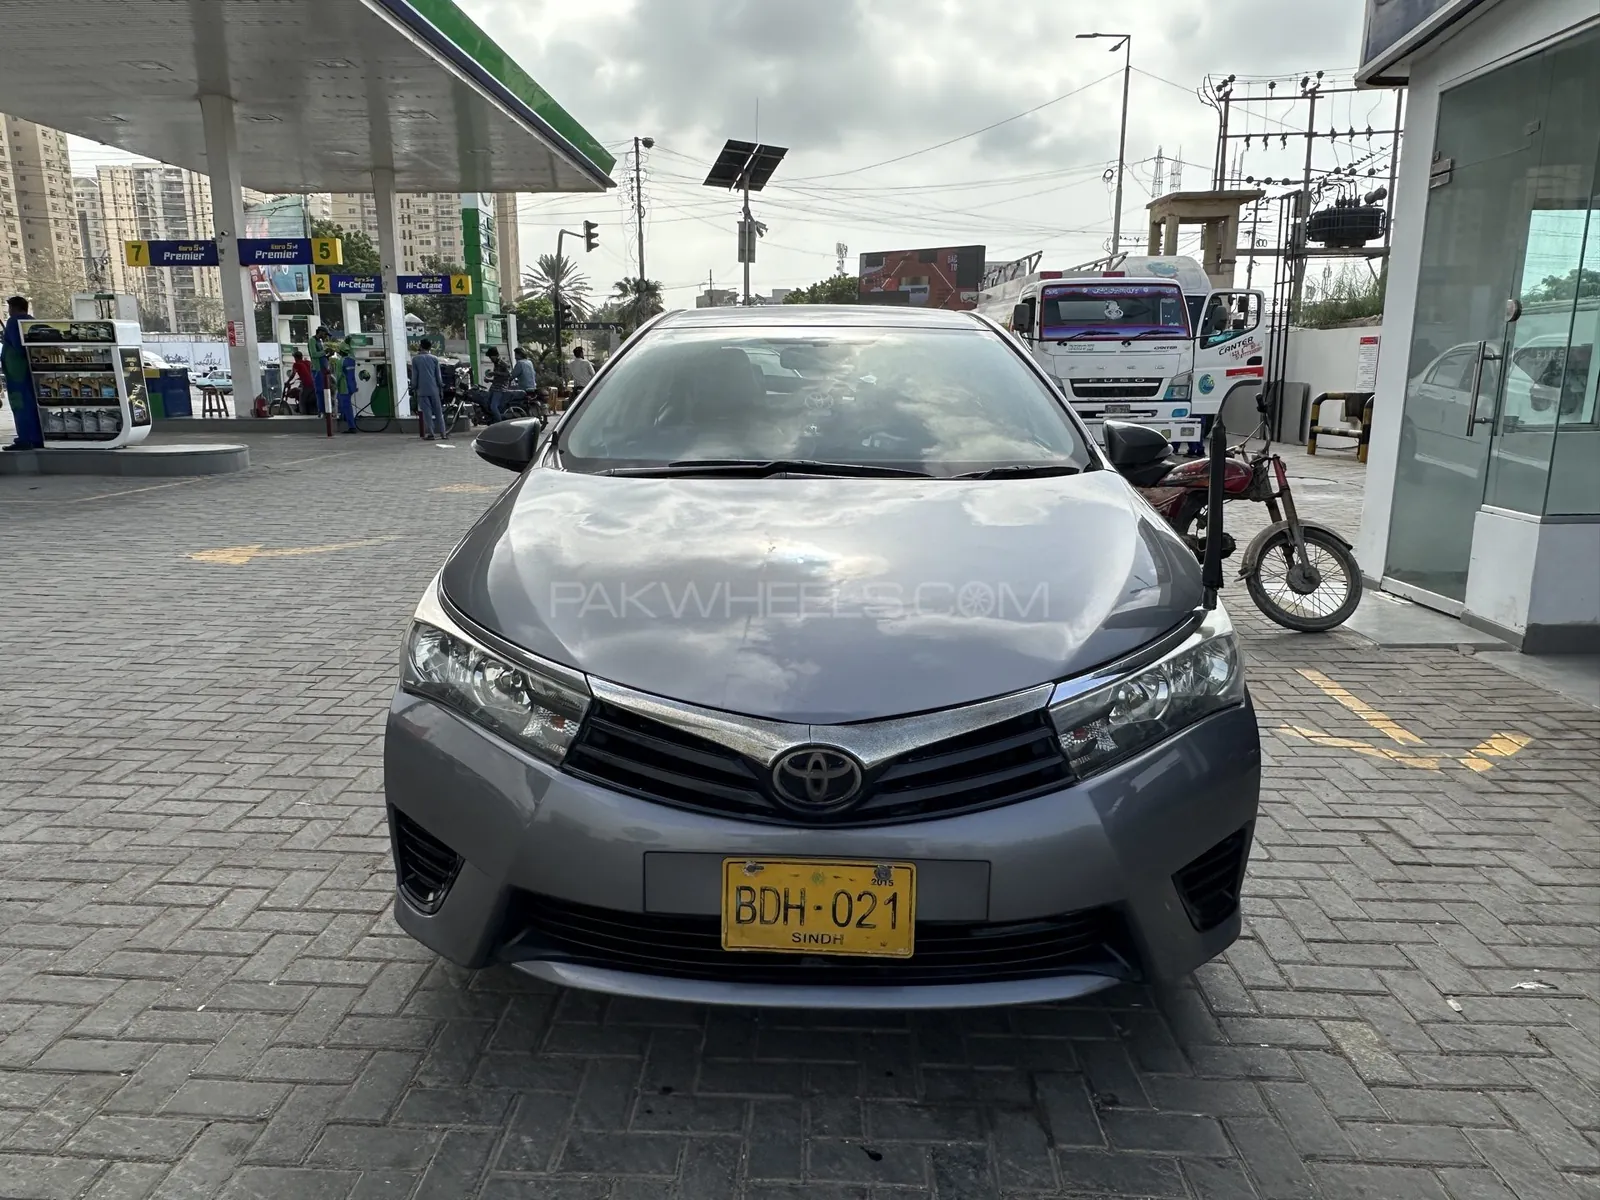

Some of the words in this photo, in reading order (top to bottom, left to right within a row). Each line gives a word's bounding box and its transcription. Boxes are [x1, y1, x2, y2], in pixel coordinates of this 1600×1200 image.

[131, 245, 142, 262] 7
[163, 251, 205, 261] Premier
[255, 250, 298, 259] Premier
[319, 242, 330, 260] 5
[316, 277, 325, 290] 2
[455, 278, 465, 291] 4
[1218, 336, 1254, 356] CANTER
[870, 877, 894, 887] 2015
[791, 932, 845, 946] SINDH
